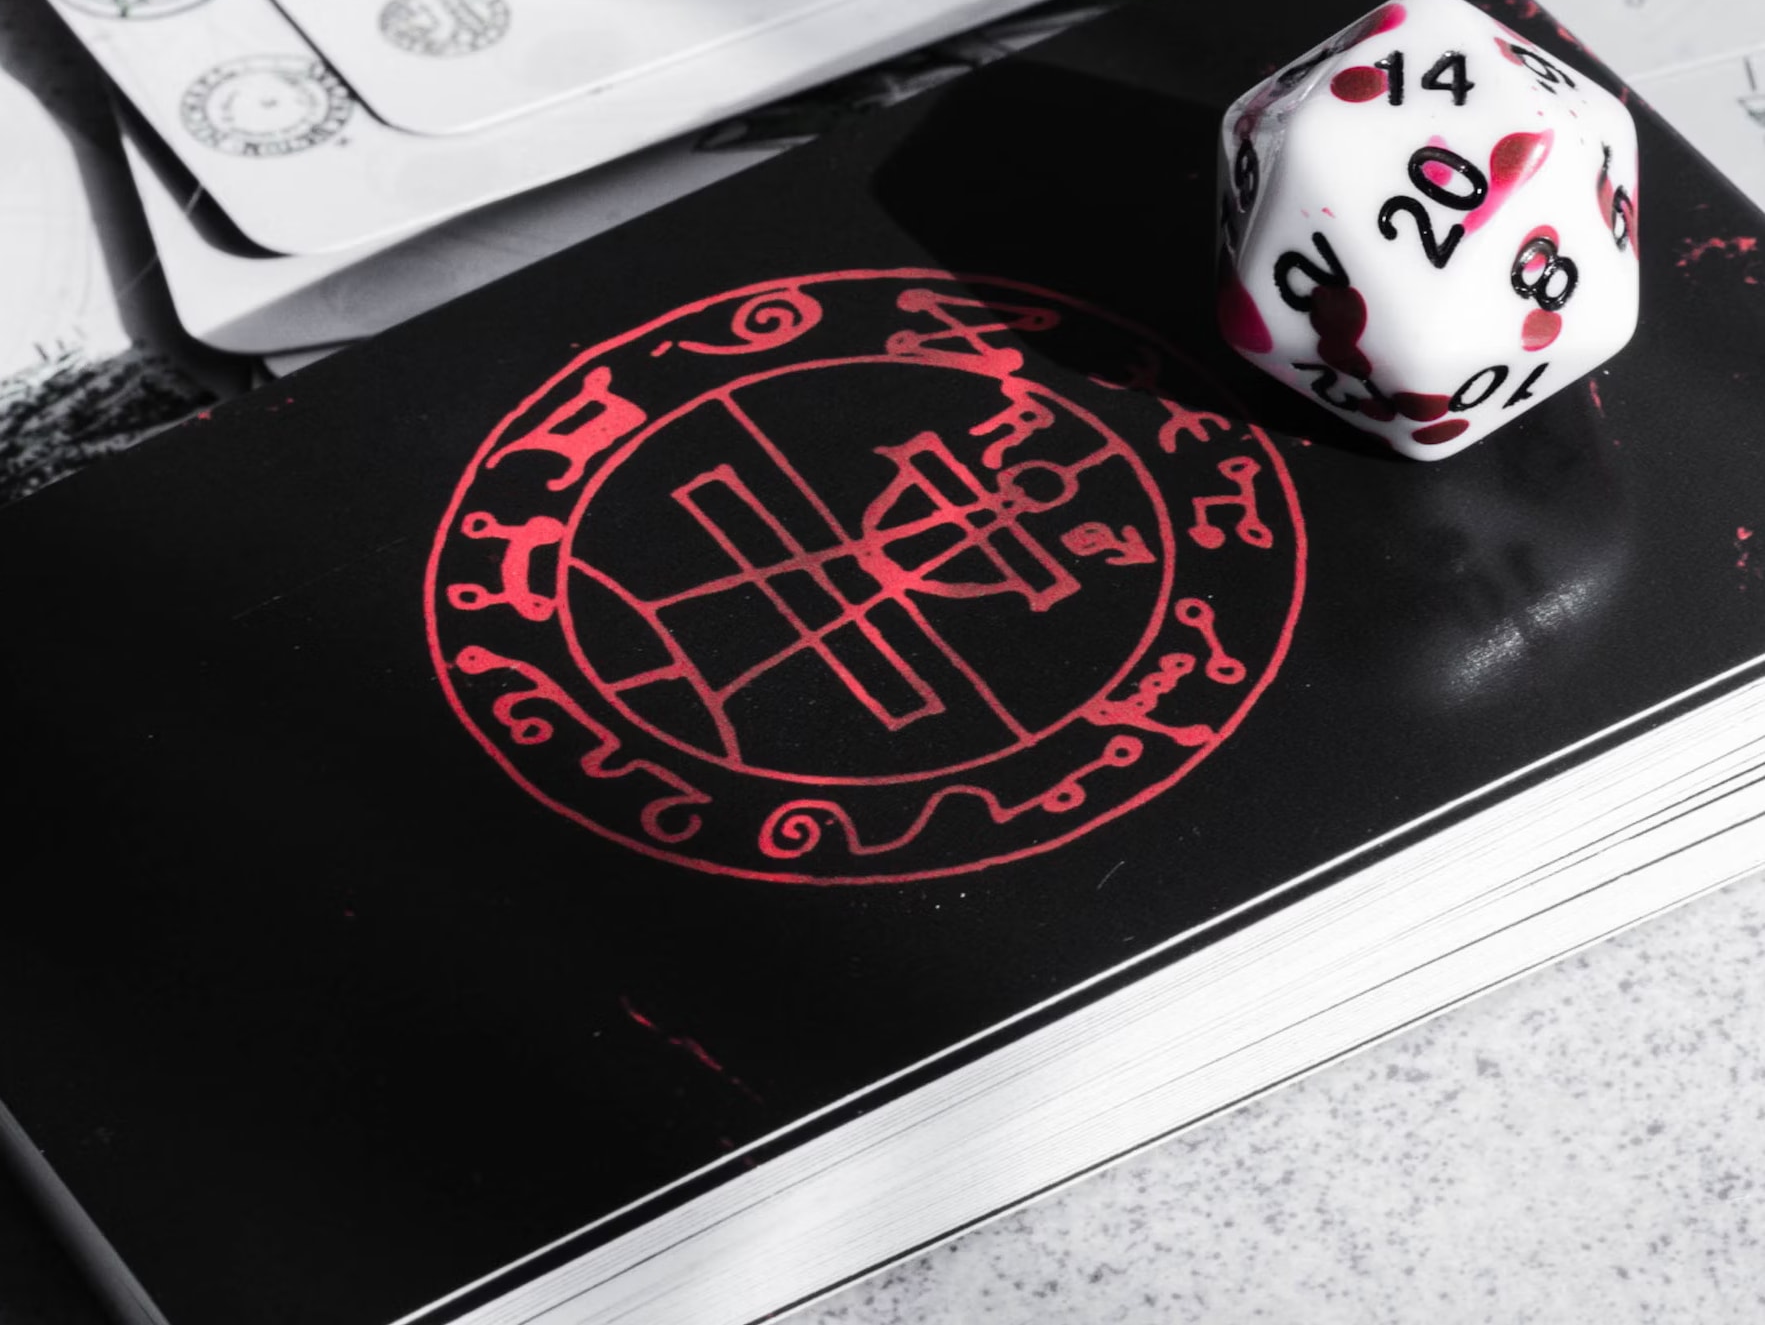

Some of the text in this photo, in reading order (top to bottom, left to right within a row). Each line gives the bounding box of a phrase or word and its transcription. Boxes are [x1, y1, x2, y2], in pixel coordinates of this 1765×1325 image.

[1375, 50, 1474, 106] 14
[1378, 145, 1489, 269] 20
[1274, 232, 1350, 312] 2
[1511, 237, 1579, 311] 8
[1449, 362, 1550, 412] 10
